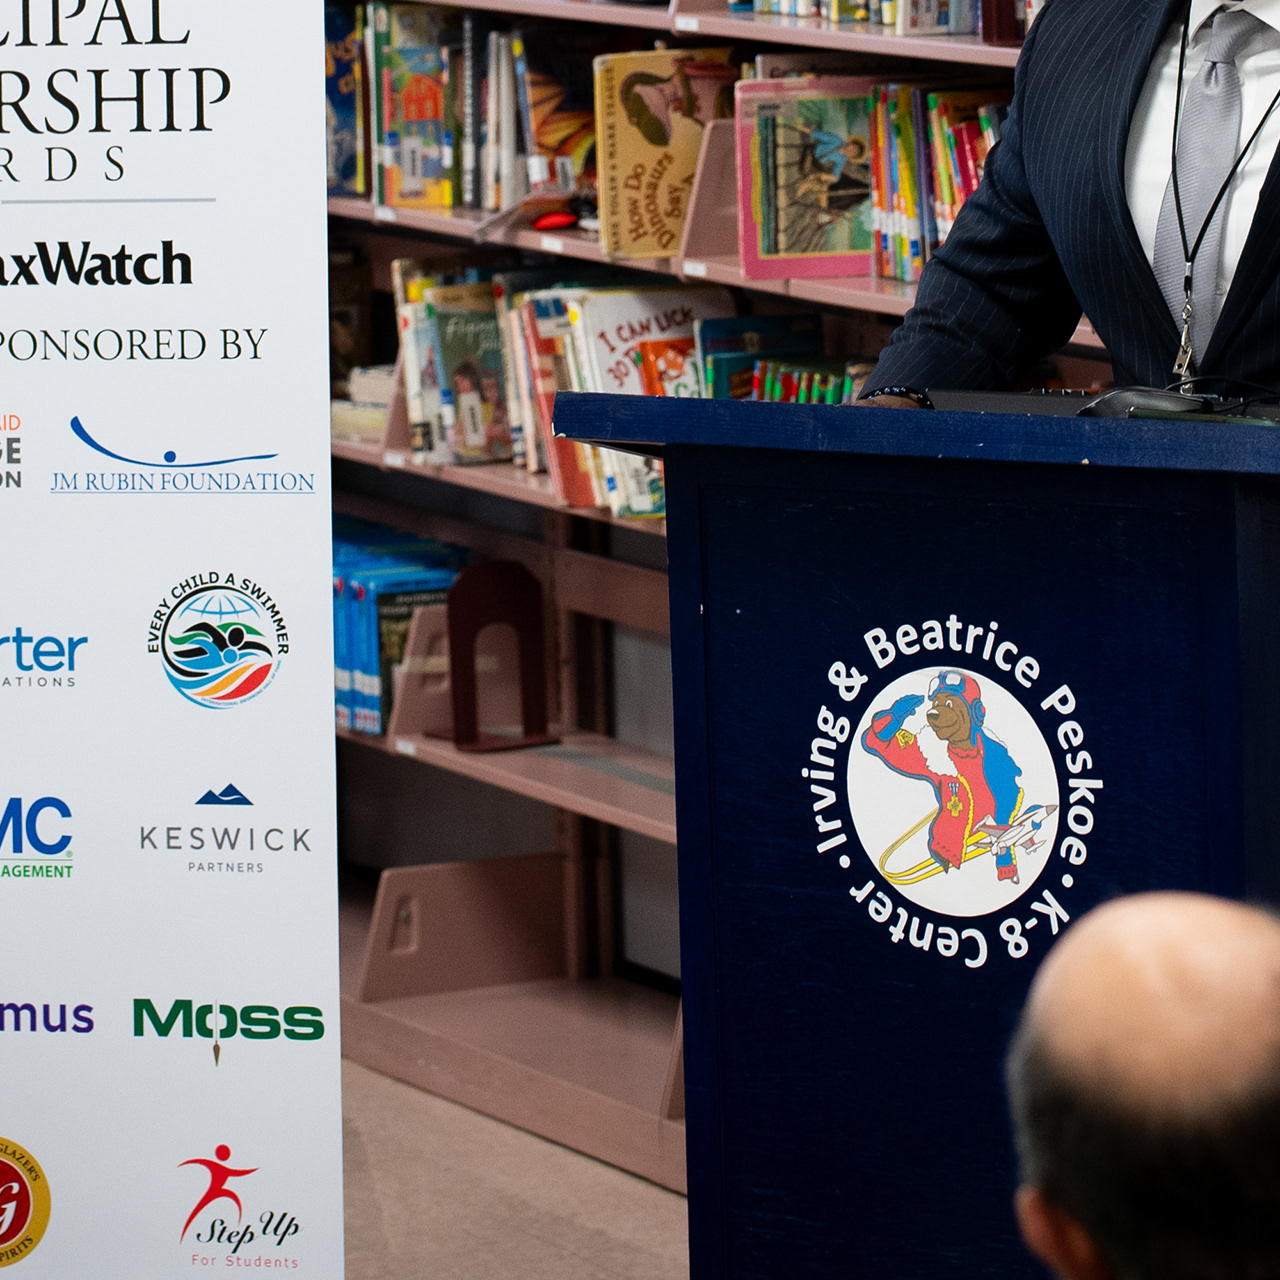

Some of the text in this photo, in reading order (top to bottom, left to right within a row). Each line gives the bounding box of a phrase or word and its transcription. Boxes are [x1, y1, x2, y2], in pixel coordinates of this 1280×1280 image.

[616, 321, 651, 344] CAN
[656, 306, 694, 333] LICK
[220, 329, 269, 360] BY
[50, 473, 315, 492] JM RUBIN FOUNDATION
[148, 571, 290, 655] EVERY CHILD A SWIMMER
[802, 614, 1104, 866] Irving & Beatrice Peskoe
[140, 826, 311, 852] KESWICK
[188, 862, 263, 873] PARTNERS
[849, 880, 1071, 969] K-8 Center
[196, 1210, 302, 1254] Step Up
[192, 1254, 298, 1269] For Students
